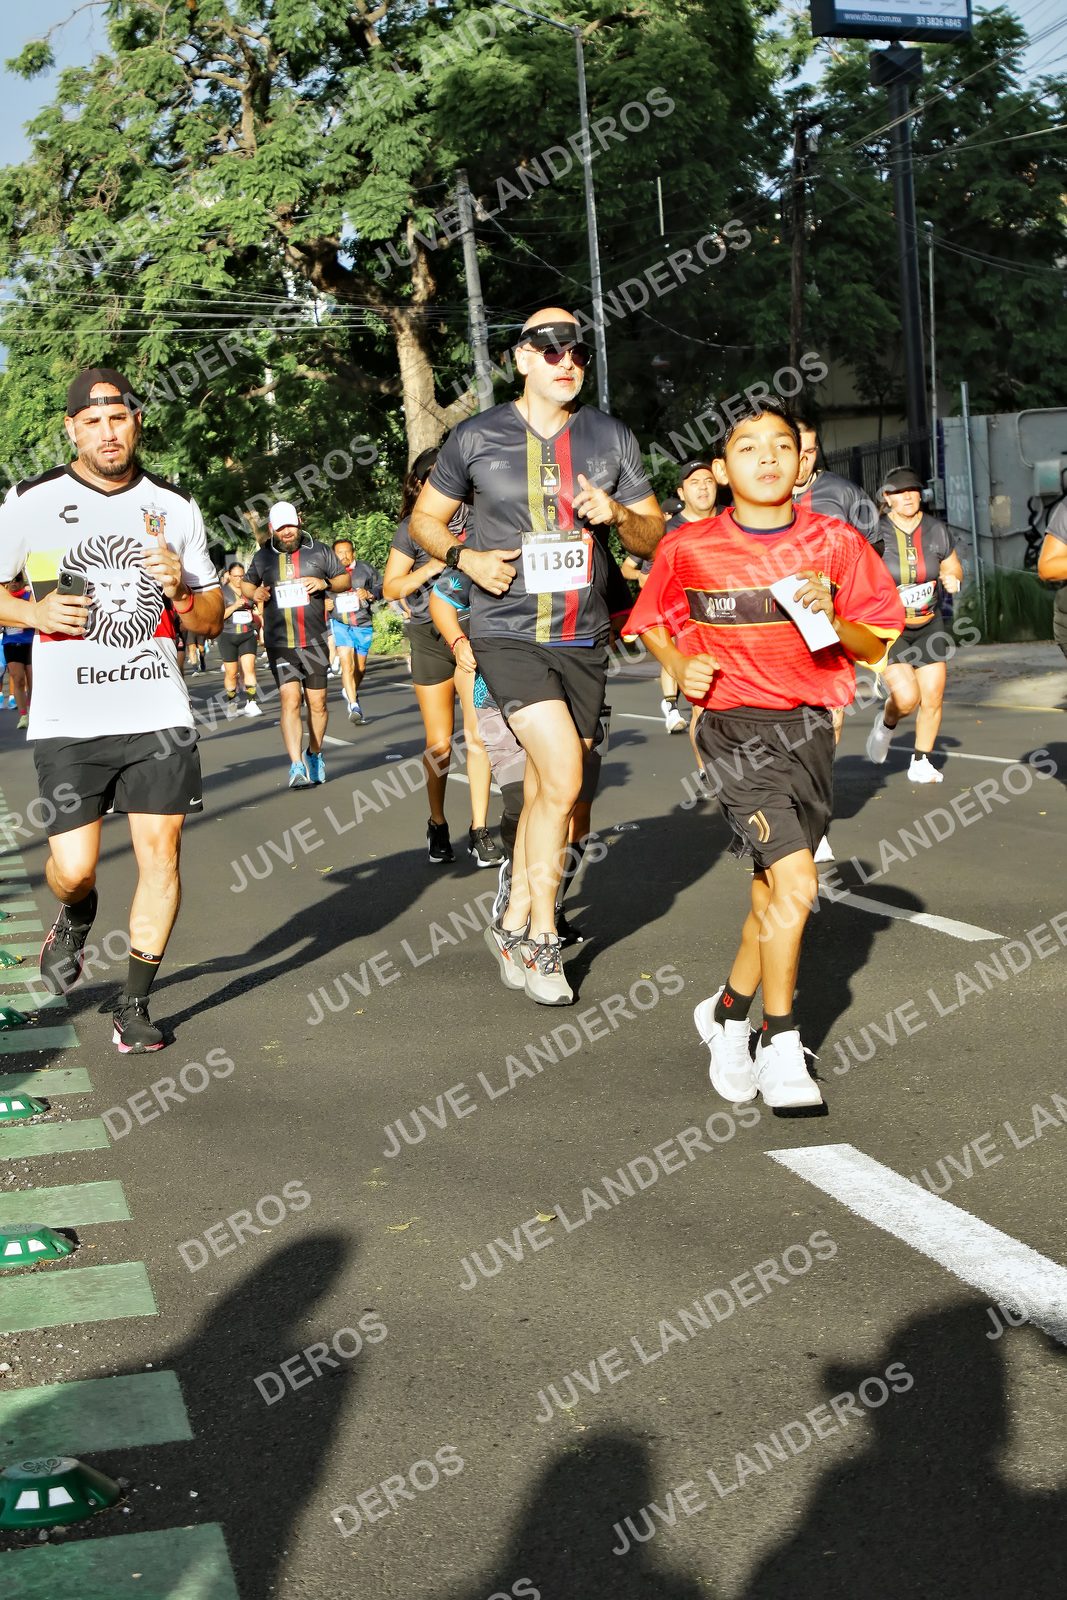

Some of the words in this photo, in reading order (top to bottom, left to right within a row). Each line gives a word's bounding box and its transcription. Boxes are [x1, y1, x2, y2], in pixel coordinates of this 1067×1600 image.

[527, 549, 584, 571] 11363
[714, 597, 736, 610] 100
[905, 586, 932, 605] 12240
[76, 661, 170, 684] Electrolit
